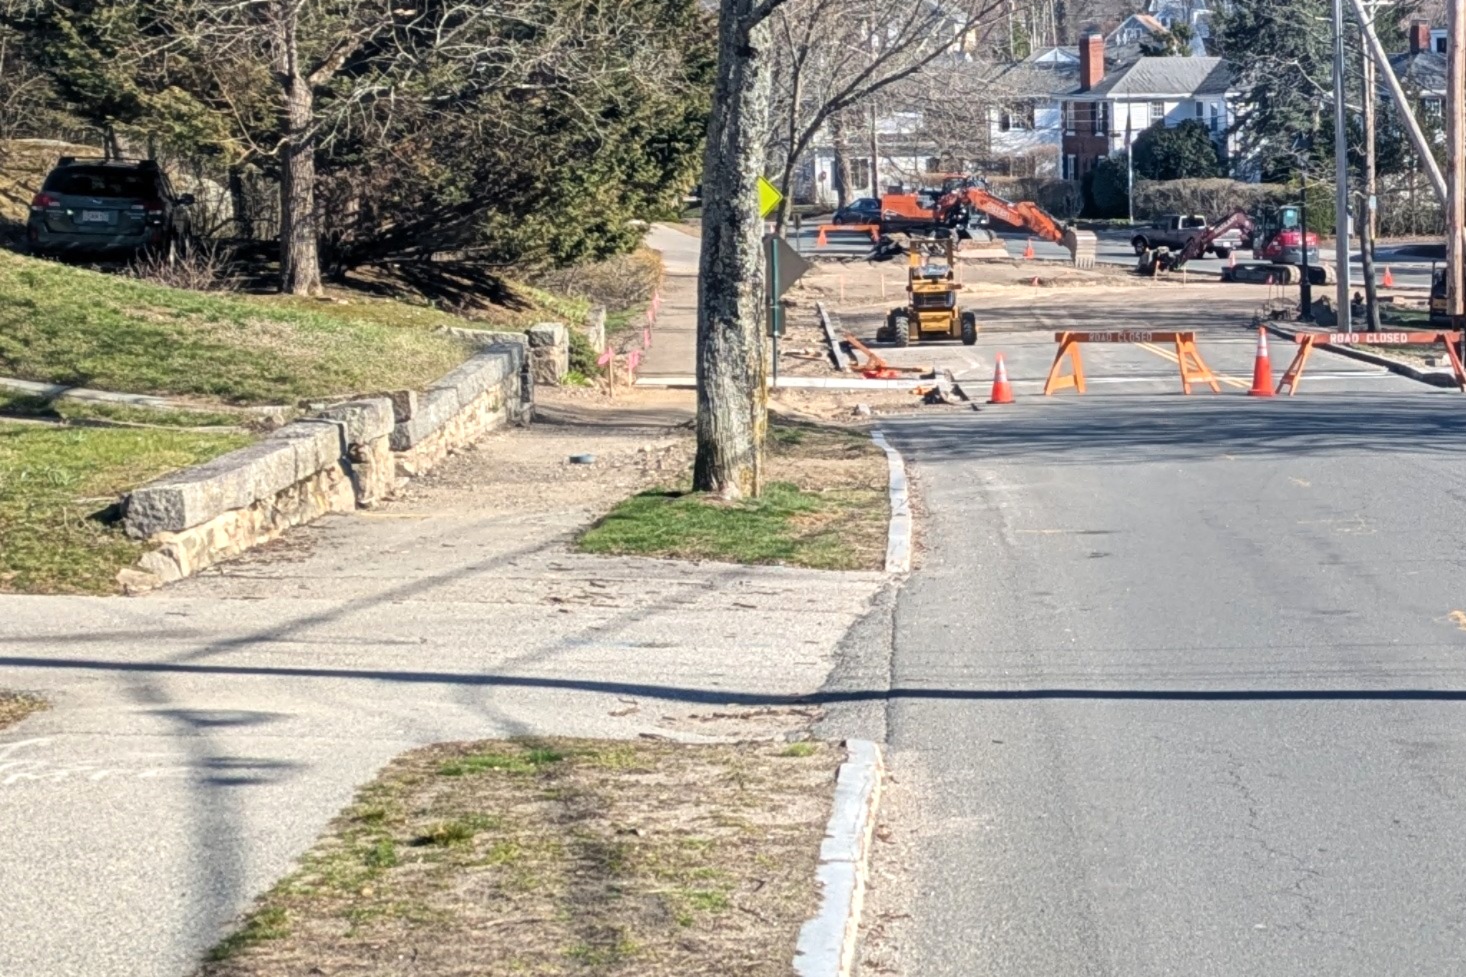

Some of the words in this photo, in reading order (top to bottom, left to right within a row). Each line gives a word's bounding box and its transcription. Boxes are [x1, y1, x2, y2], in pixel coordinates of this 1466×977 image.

[1088, 332, 1112, 342] ROAD
[1117, 332, 1153, 342] CLOSED
[1329, 333, 1360, 343] ROAD
[1365, 332, 1408, 343] CLOSED
